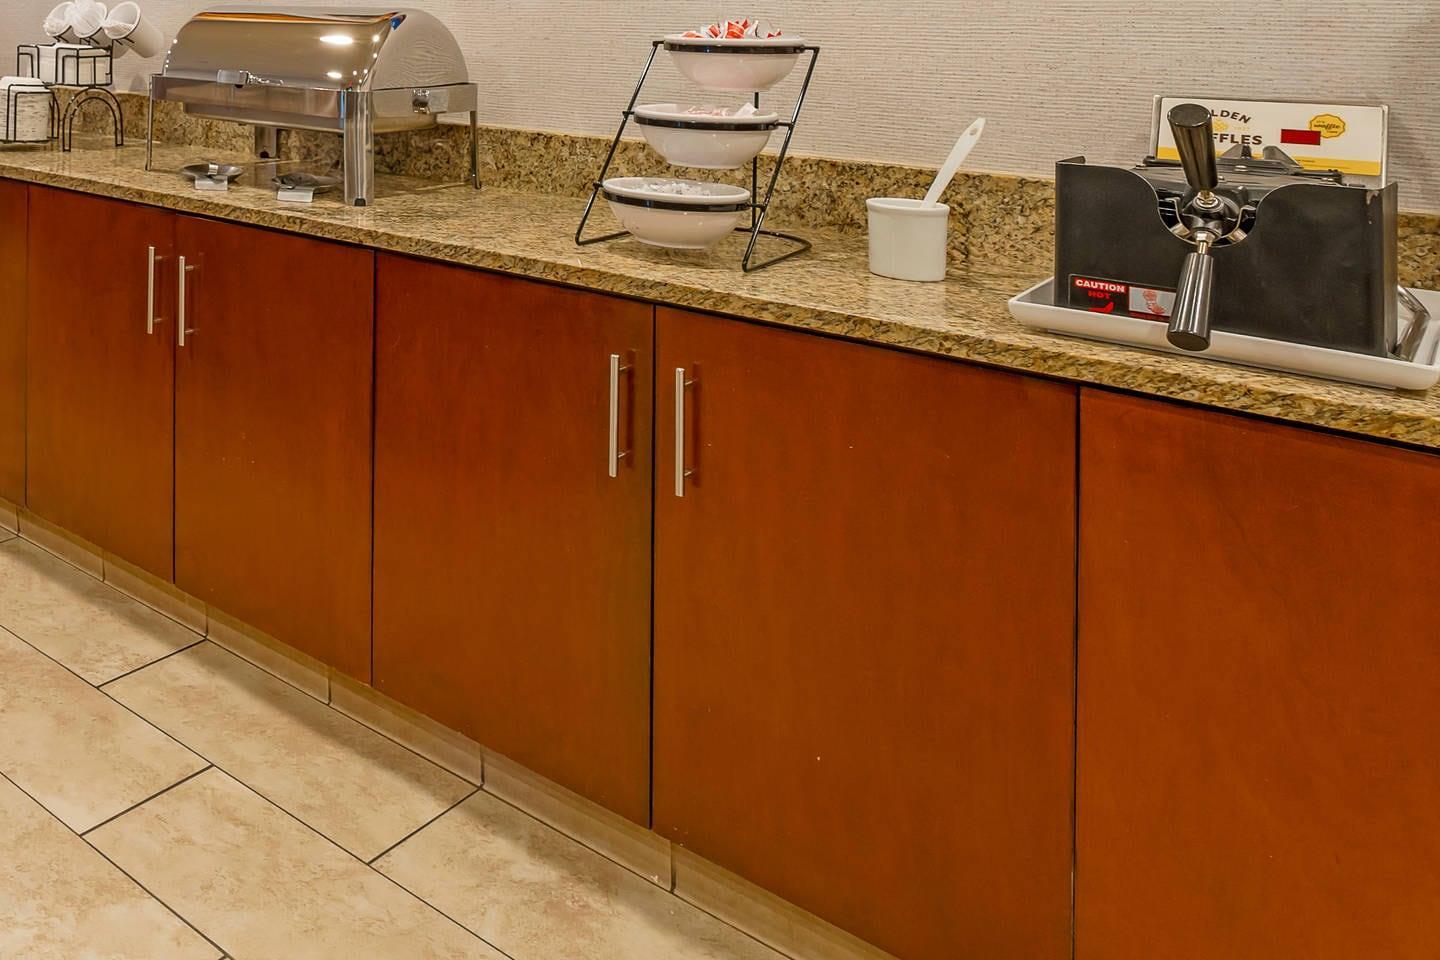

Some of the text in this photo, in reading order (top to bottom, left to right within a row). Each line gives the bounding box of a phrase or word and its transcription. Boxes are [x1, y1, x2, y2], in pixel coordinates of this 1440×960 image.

[1210, 109, 1252, 124] LDEN
[1075, 279, 1126, 293] CAUTION
[1088, 291, 1111, 299] HOT
